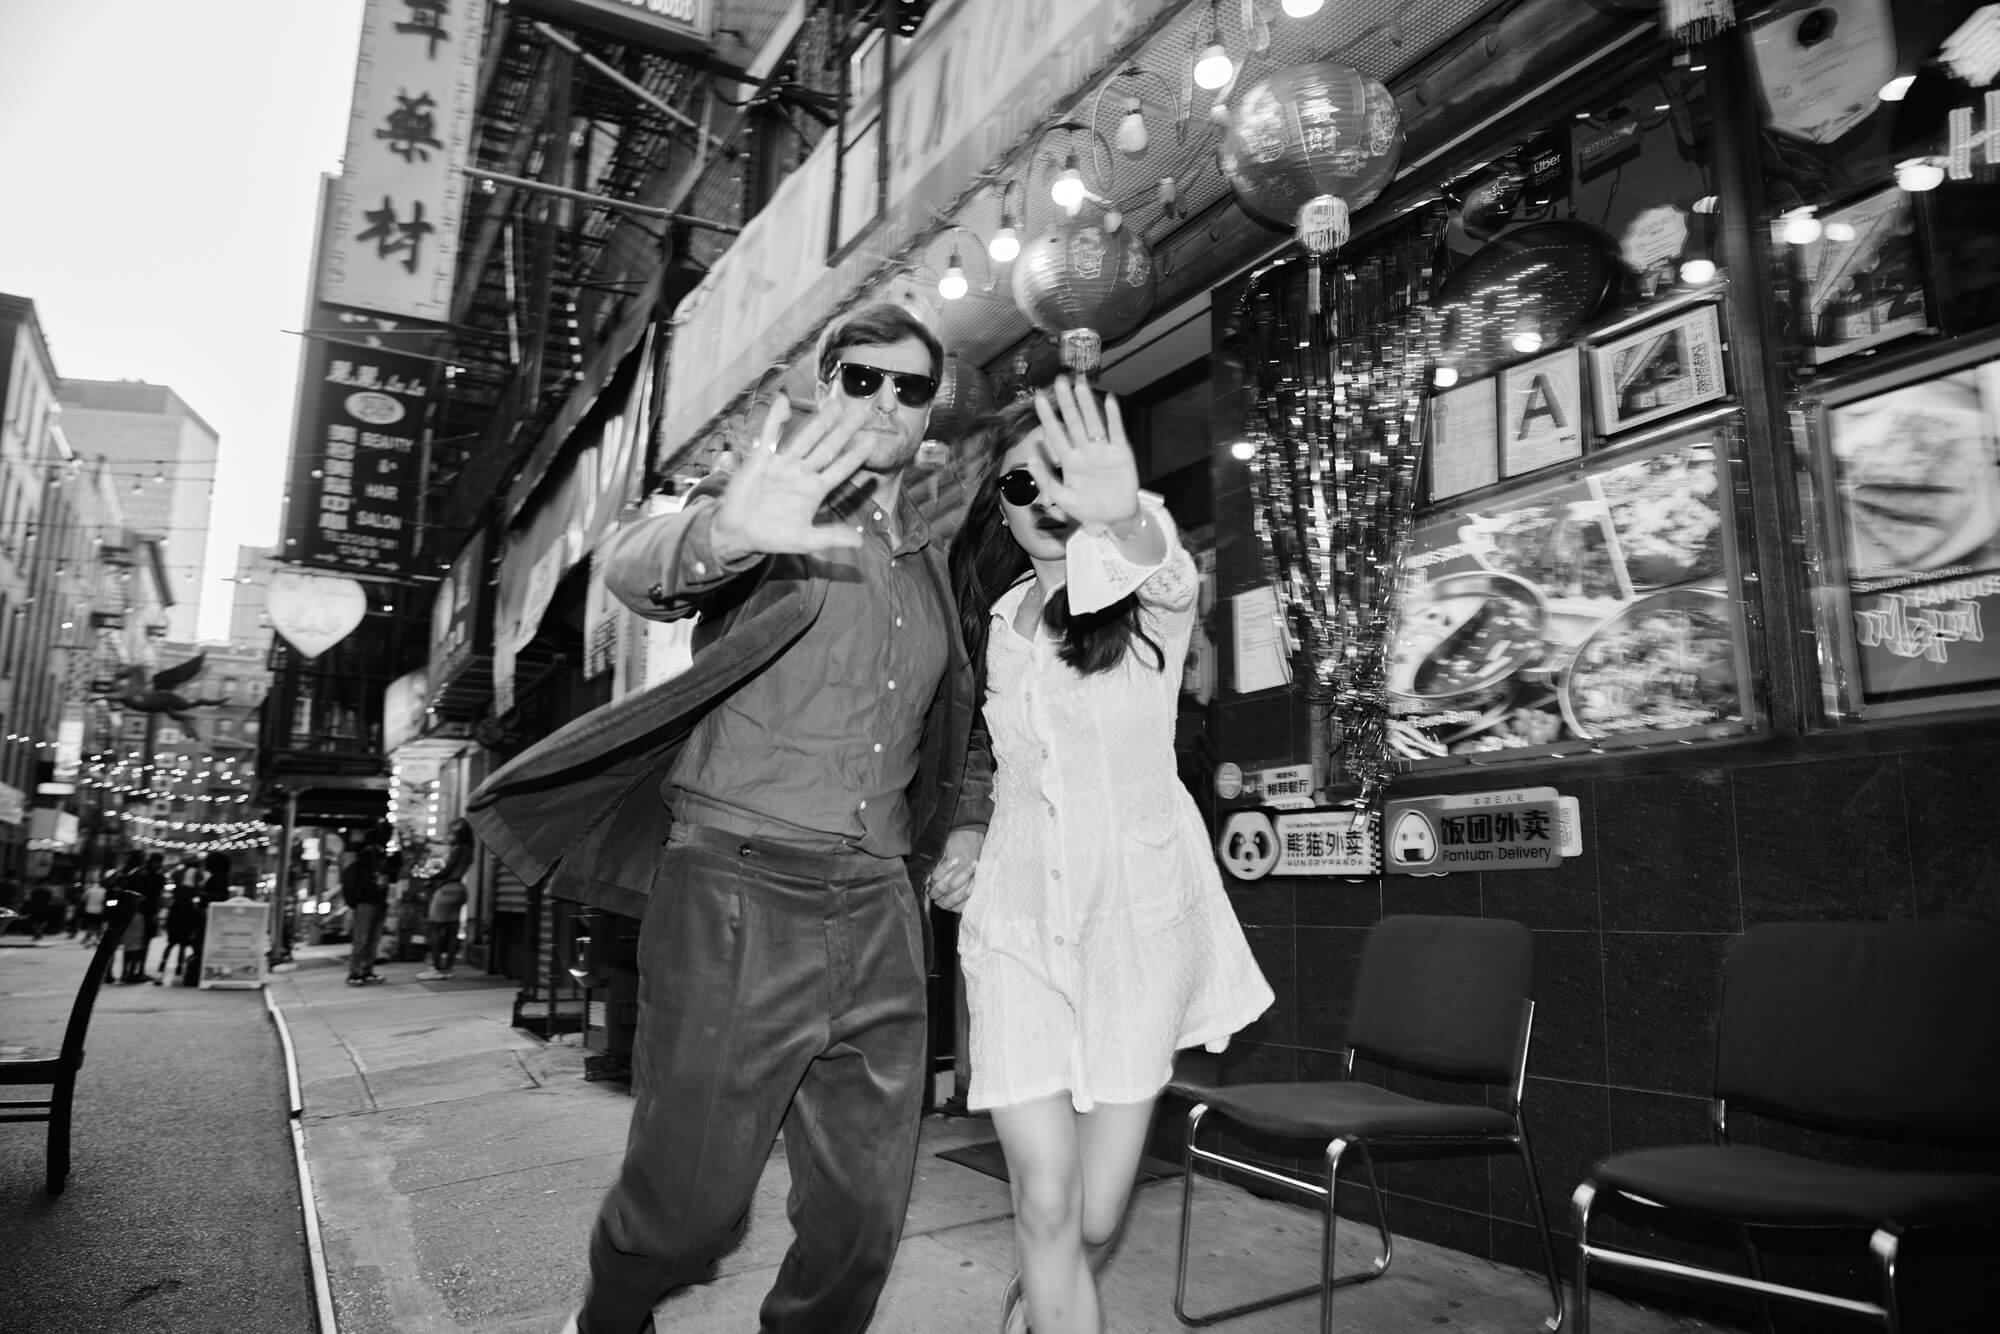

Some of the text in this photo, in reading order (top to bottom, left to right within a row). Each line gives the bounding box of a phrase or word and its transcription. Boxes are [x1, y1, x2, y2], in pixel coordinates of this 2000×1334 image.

[1534, 153, 1562, 174] Uber
[1516, 371, 1568, 441] A
[355, 510, 402, 530] SALON
[1440, 809, 1551, 846] 饭团外卖
[1287, 831, 1363, 857] 熊猫外卖
[1442, 847, 1552, 862] Fantuan Delivery
